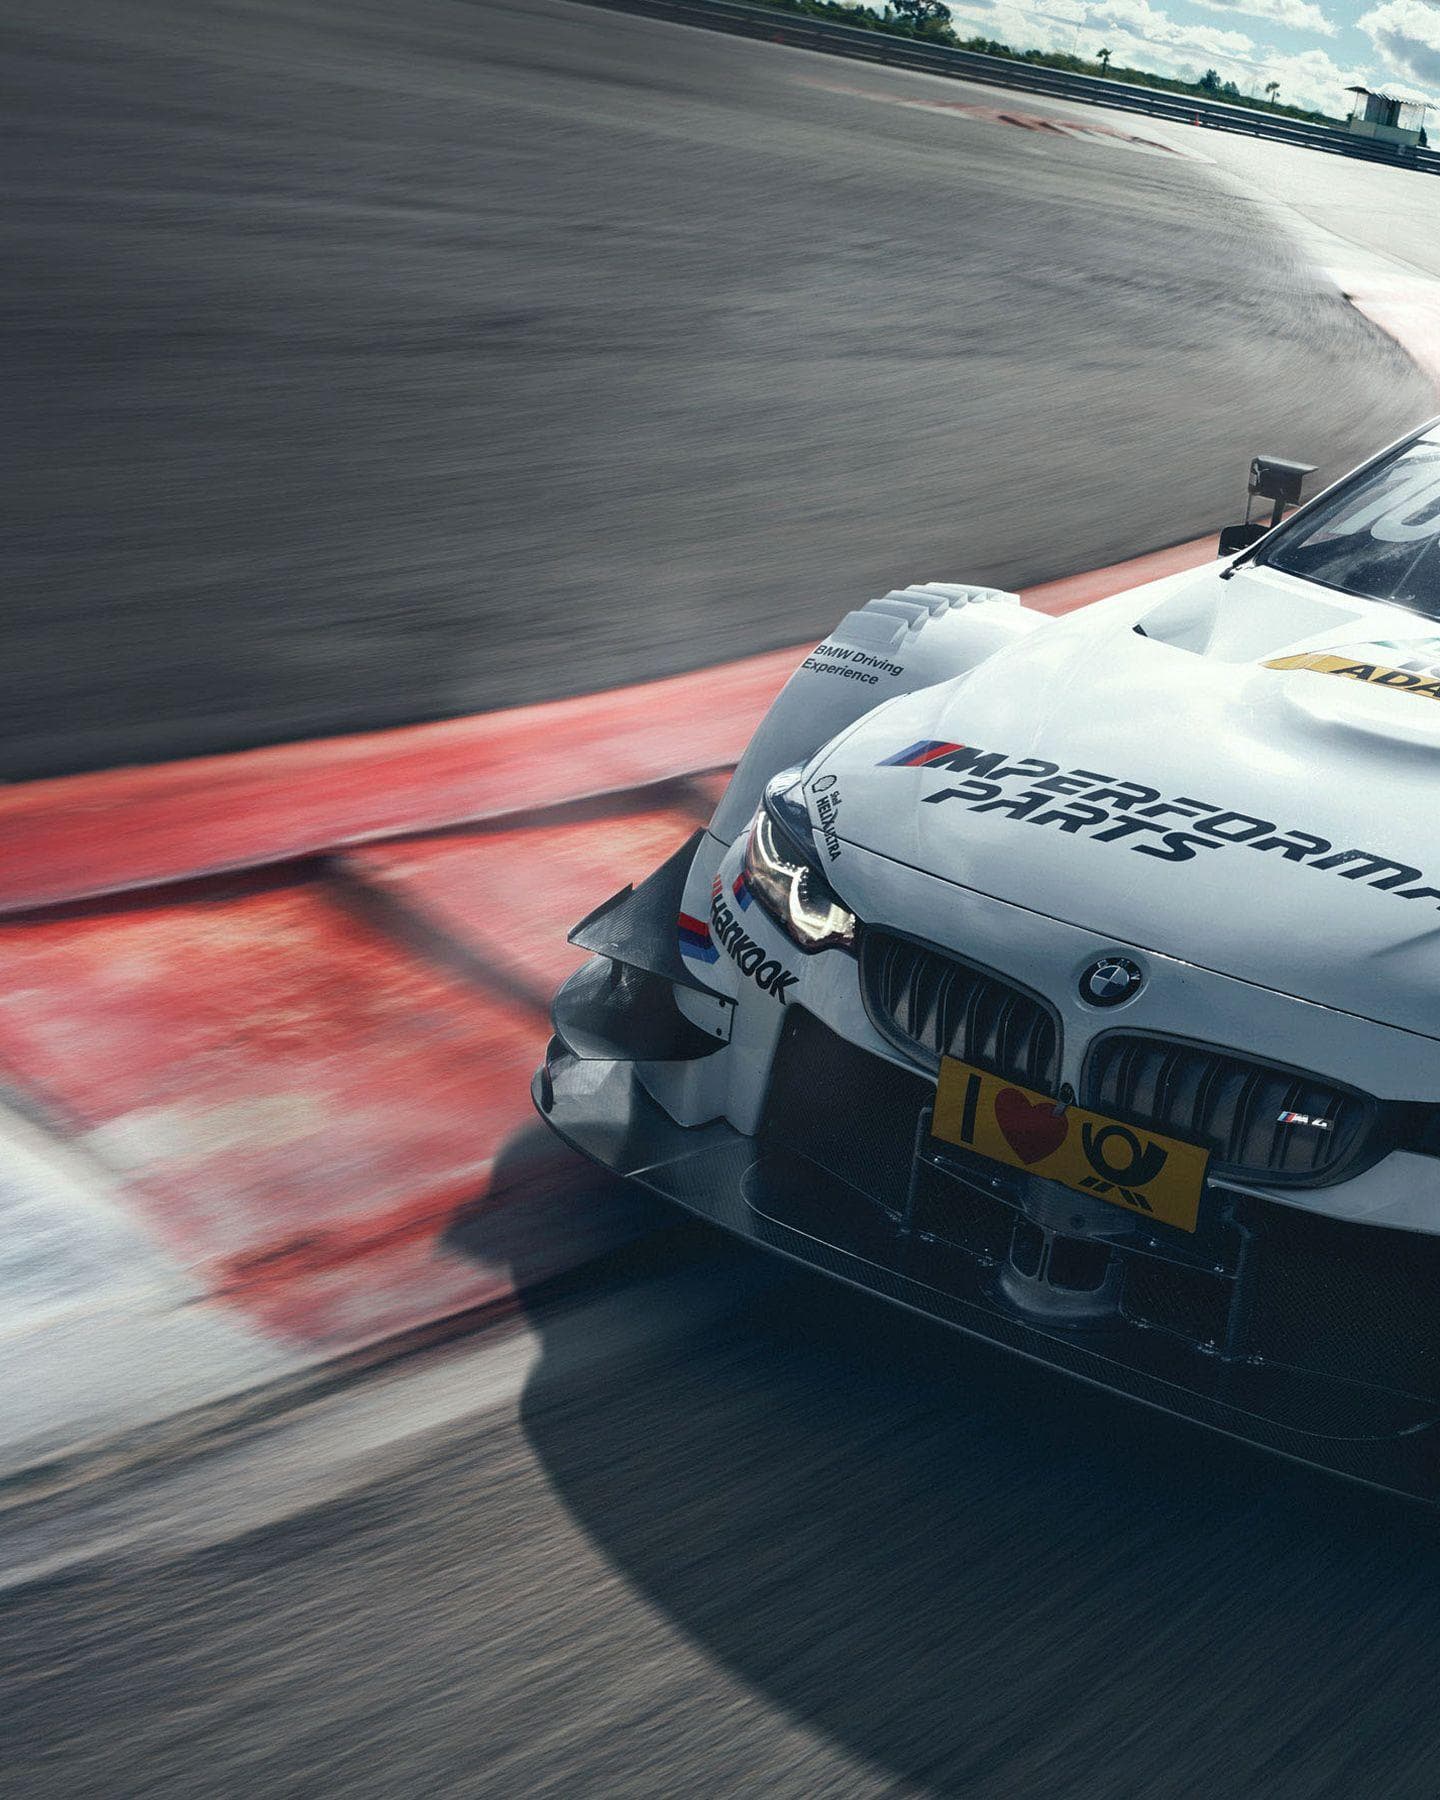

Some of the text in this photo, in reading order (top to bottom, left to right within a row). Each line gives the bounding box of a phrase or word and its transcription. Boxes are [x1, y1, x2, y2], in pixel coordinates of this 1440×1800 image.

[801, 658, 879, 685] Experience
[814, 644, 905, 677] BMW Driving
[921, 779, 1226, 862] PARTS
